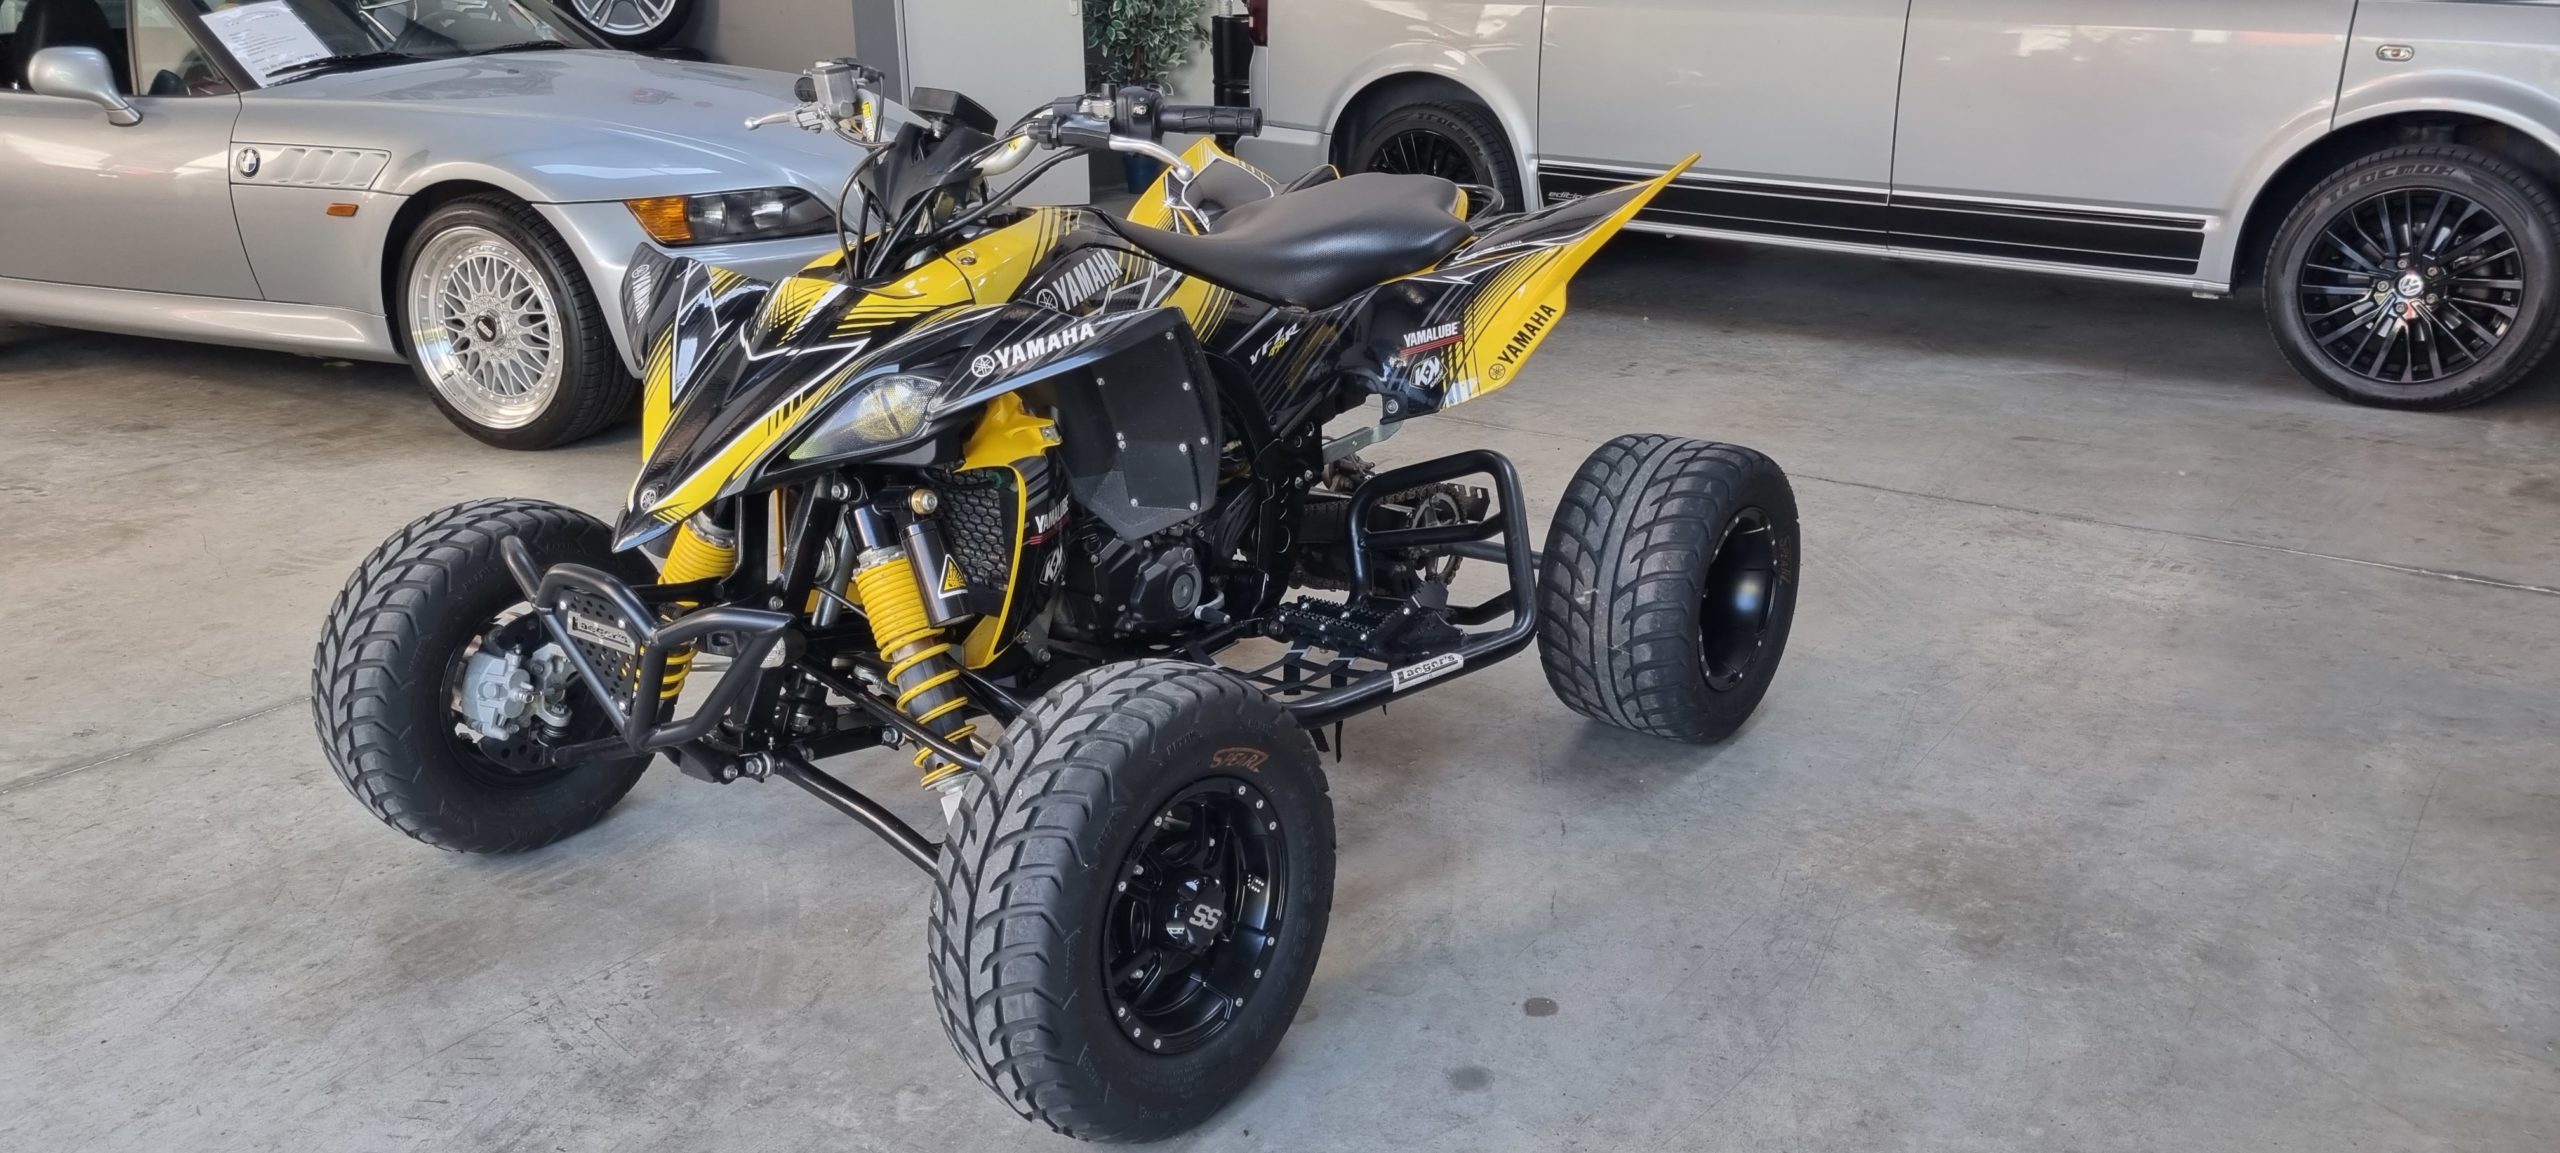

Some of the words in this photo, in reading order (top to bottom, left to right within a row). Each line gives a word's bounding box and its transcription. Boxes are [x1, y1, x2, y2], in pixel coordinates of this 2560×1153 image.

[1548, 191, 1585, 200] editio
[632, 272, 651, 324] YAMAHA
[1052, 249, 1123, 312] YAMAHA
[994, 322, 1096, 369] YAMAHA
[1403, 322, 1459, 347] YAMALUBE
[1498, 304, 1557, 365] YAMAHA
[1210, 747, 1269, 773] SPEARZ
[1189, 904, 1223, 930] SS
